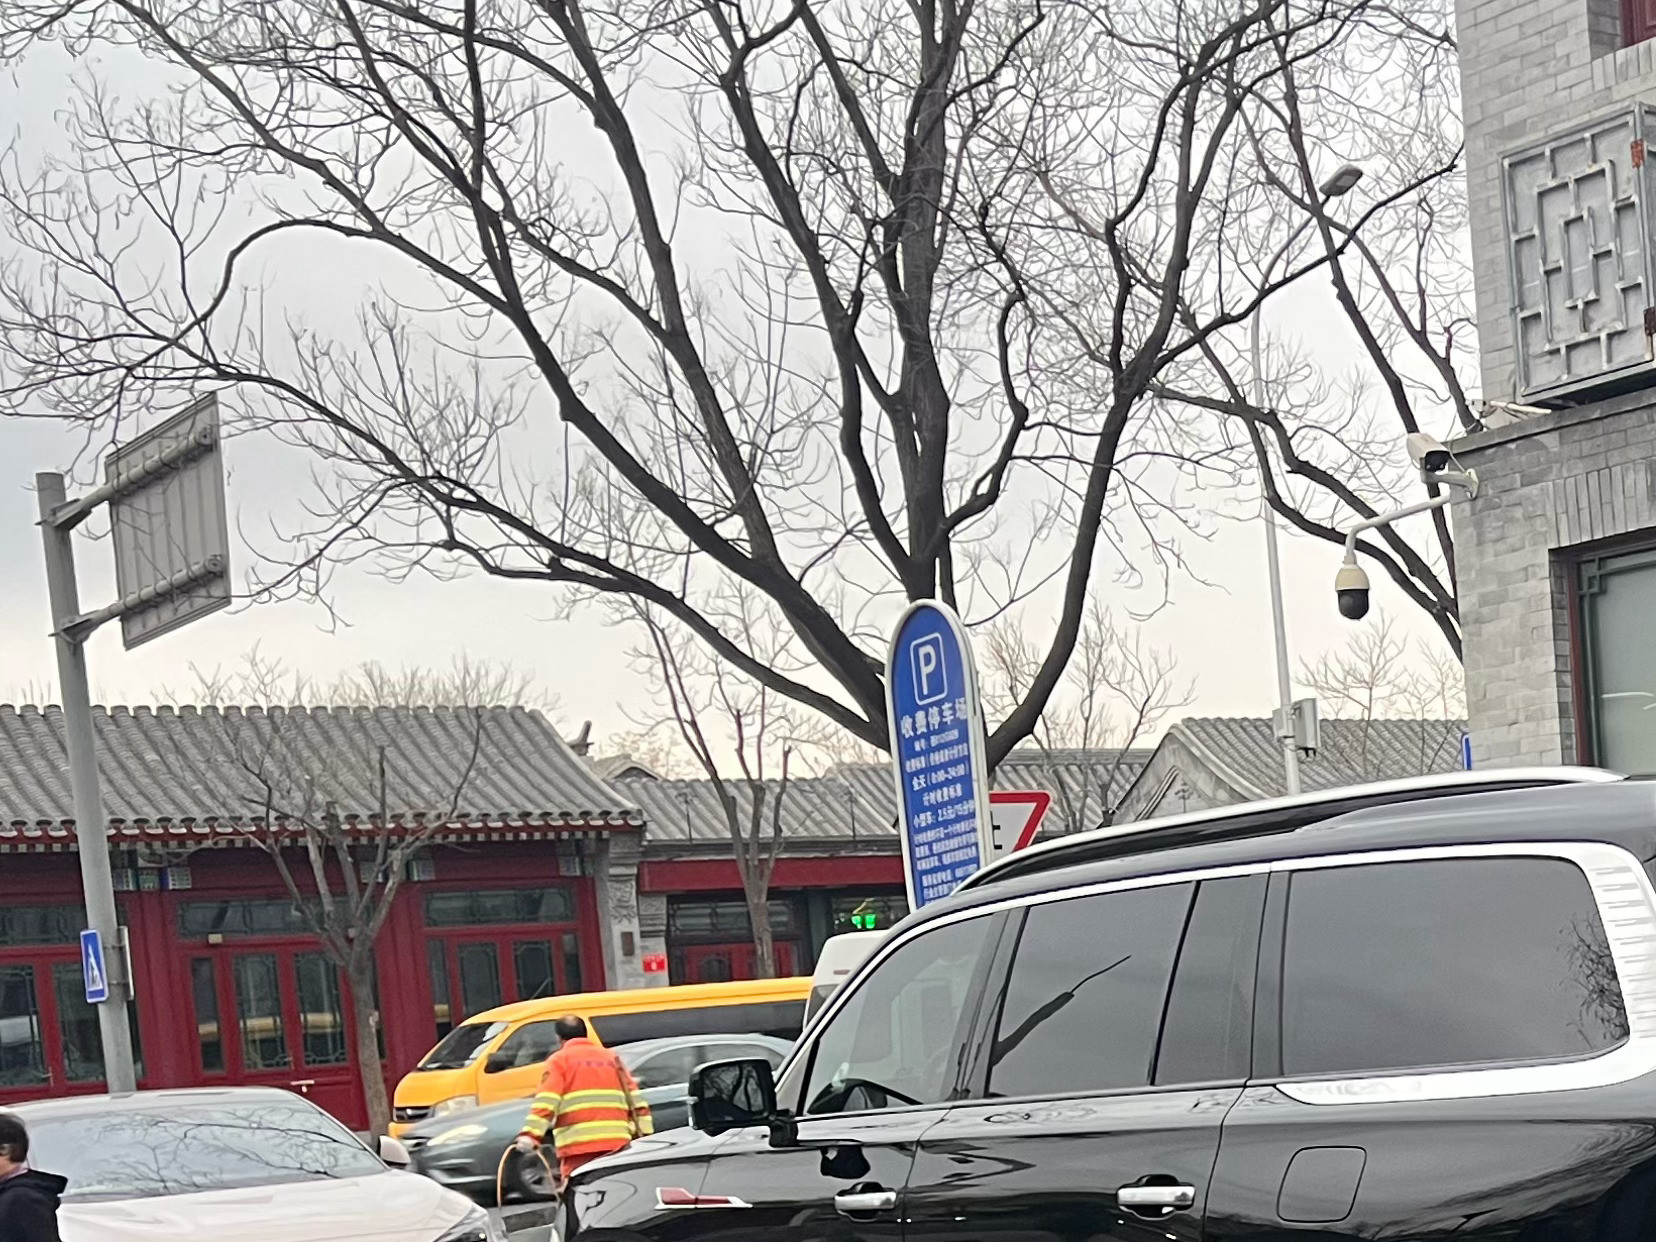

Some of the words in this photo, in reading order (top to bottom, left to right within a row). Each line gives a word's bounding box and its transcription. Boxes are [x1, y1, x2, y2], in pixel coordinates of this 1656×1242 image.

[919, 644, 937, 696] P
[900, 697, 968, 739] 收费停车场
